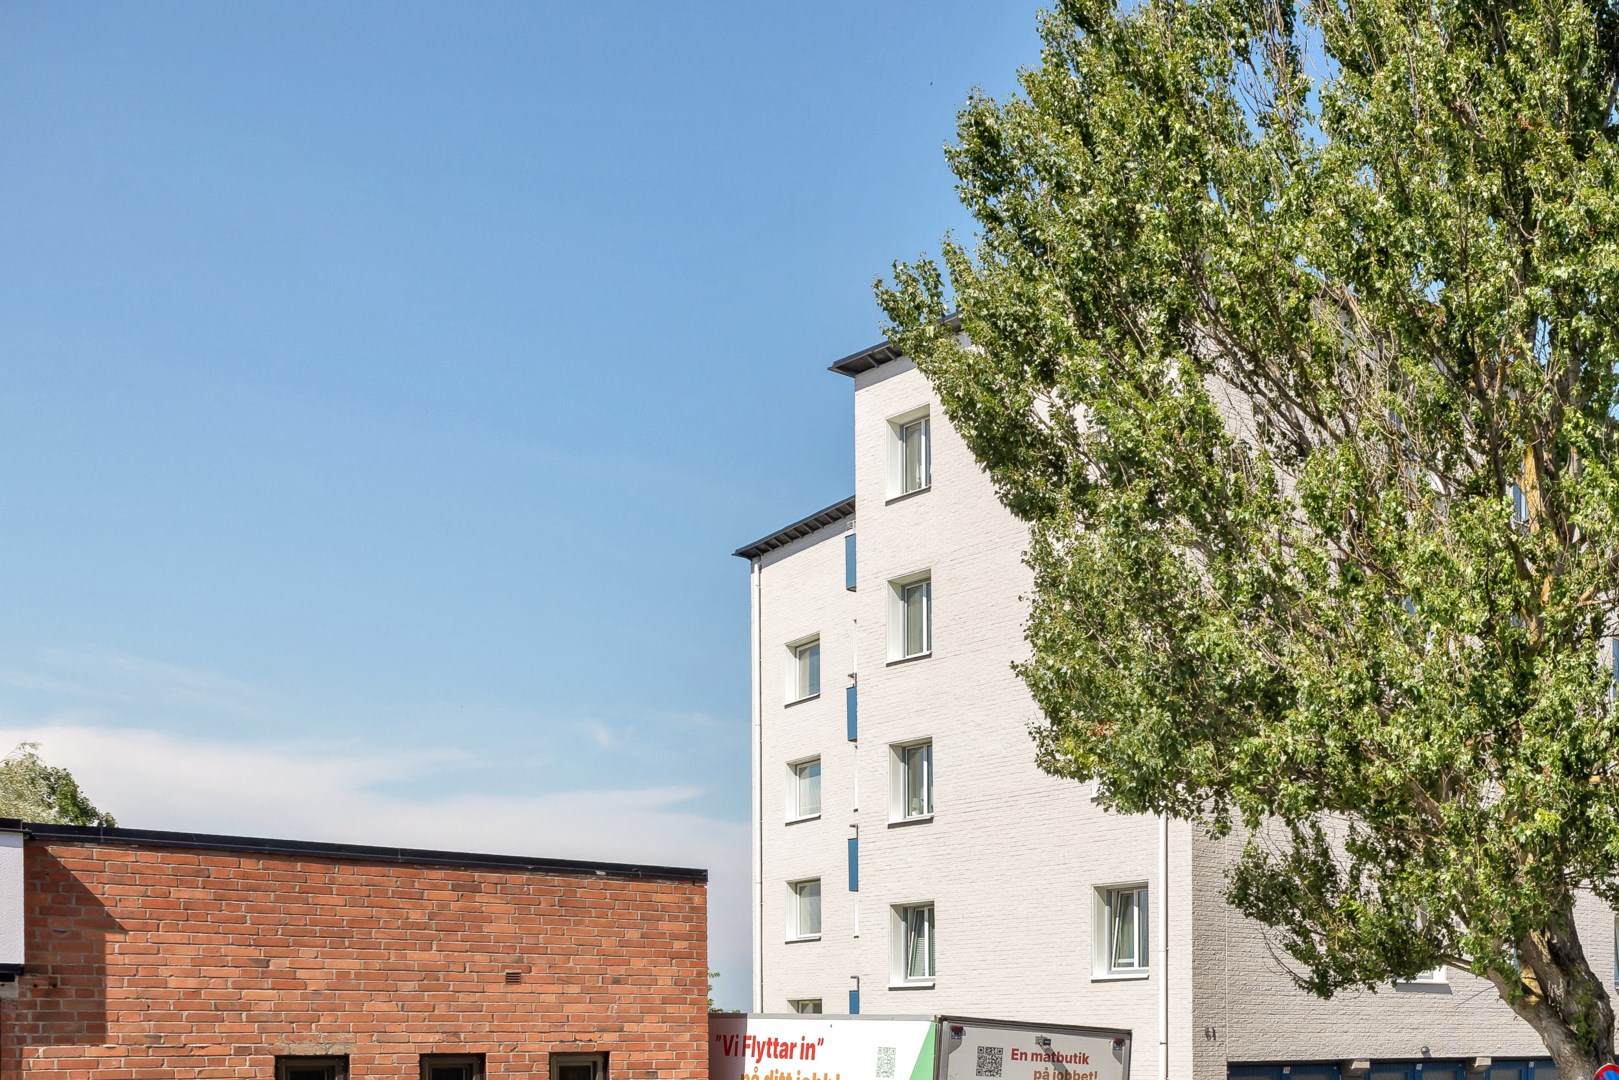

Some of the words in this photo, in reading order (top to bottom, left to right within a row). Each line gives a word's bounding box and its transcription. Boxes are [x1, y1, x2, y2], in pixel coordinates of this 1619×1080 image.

[741, 1035, 797, 1064] Flyttar
[1010, 1048, 1028, 1061] En
[1030, 1051, 1090, 1065] matbutik
